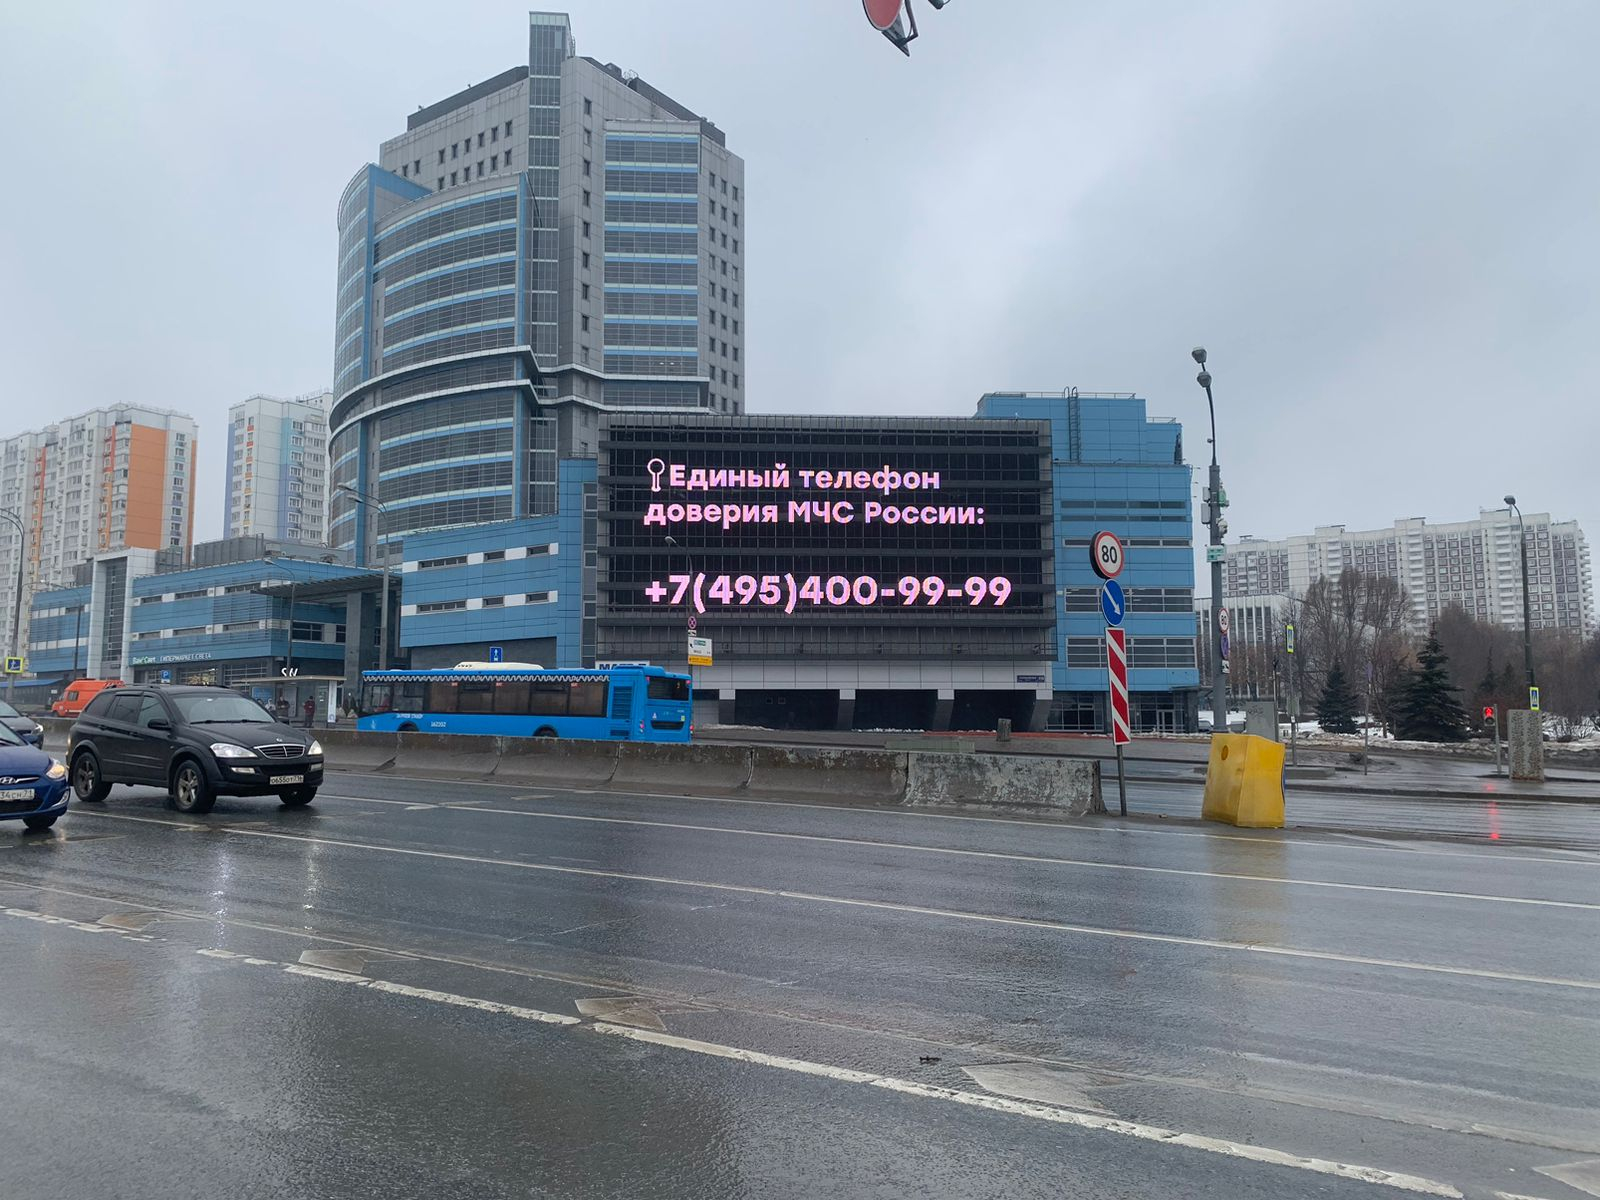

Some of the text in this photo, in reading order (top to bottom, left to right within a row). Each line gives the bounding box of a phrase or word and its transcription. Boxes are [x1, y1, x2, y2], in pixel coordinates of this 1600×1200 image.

[668, 461, 941, 494] Единый телефон
[643, 500, 985, 530] доверия МЧС России:
[1101, 545, 1118, 564] 80
[644, 571, 1013, 616] +7(495)400-99-99
